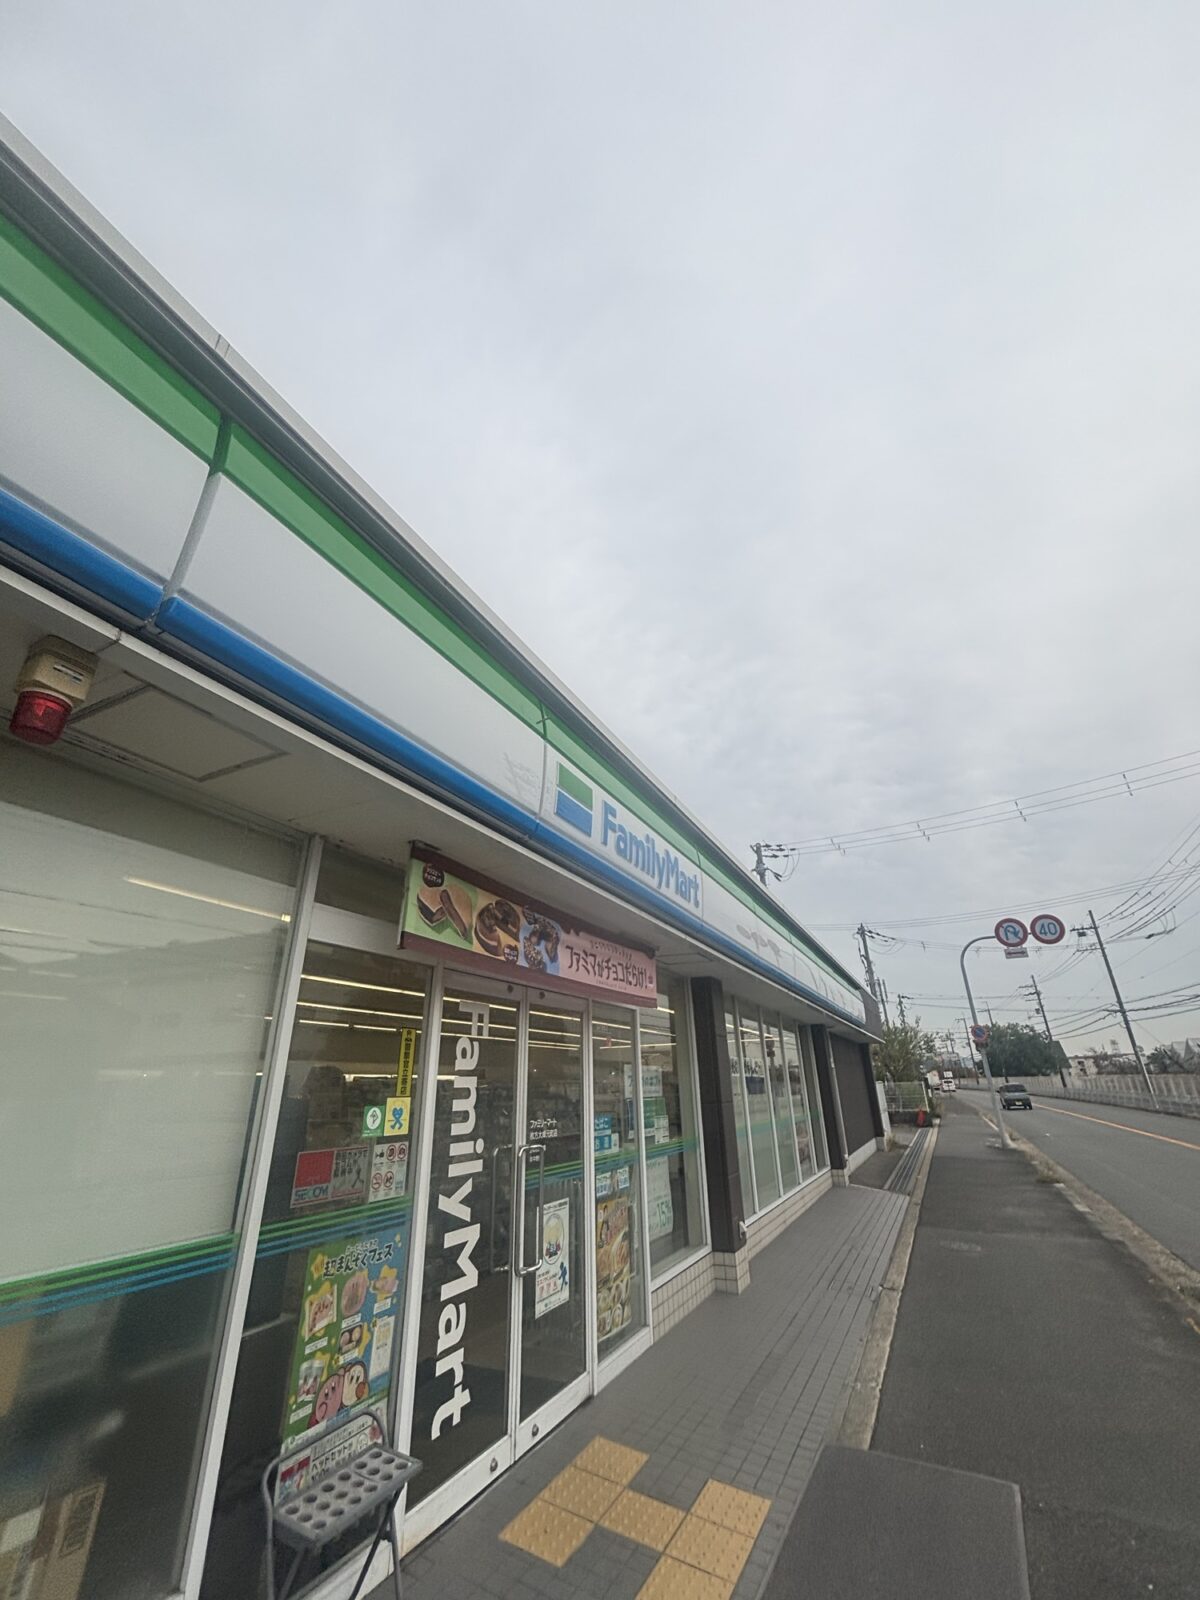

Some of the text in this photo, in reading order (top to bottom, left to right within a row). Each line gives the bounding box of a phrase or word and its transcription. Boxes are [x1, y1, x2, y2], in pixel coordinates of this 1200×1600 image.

[602, 799, 700, 908] FamilyMart
[1040, 922, 1057, 936] 40
[431, 999, 491, 1440] FamilyMart
